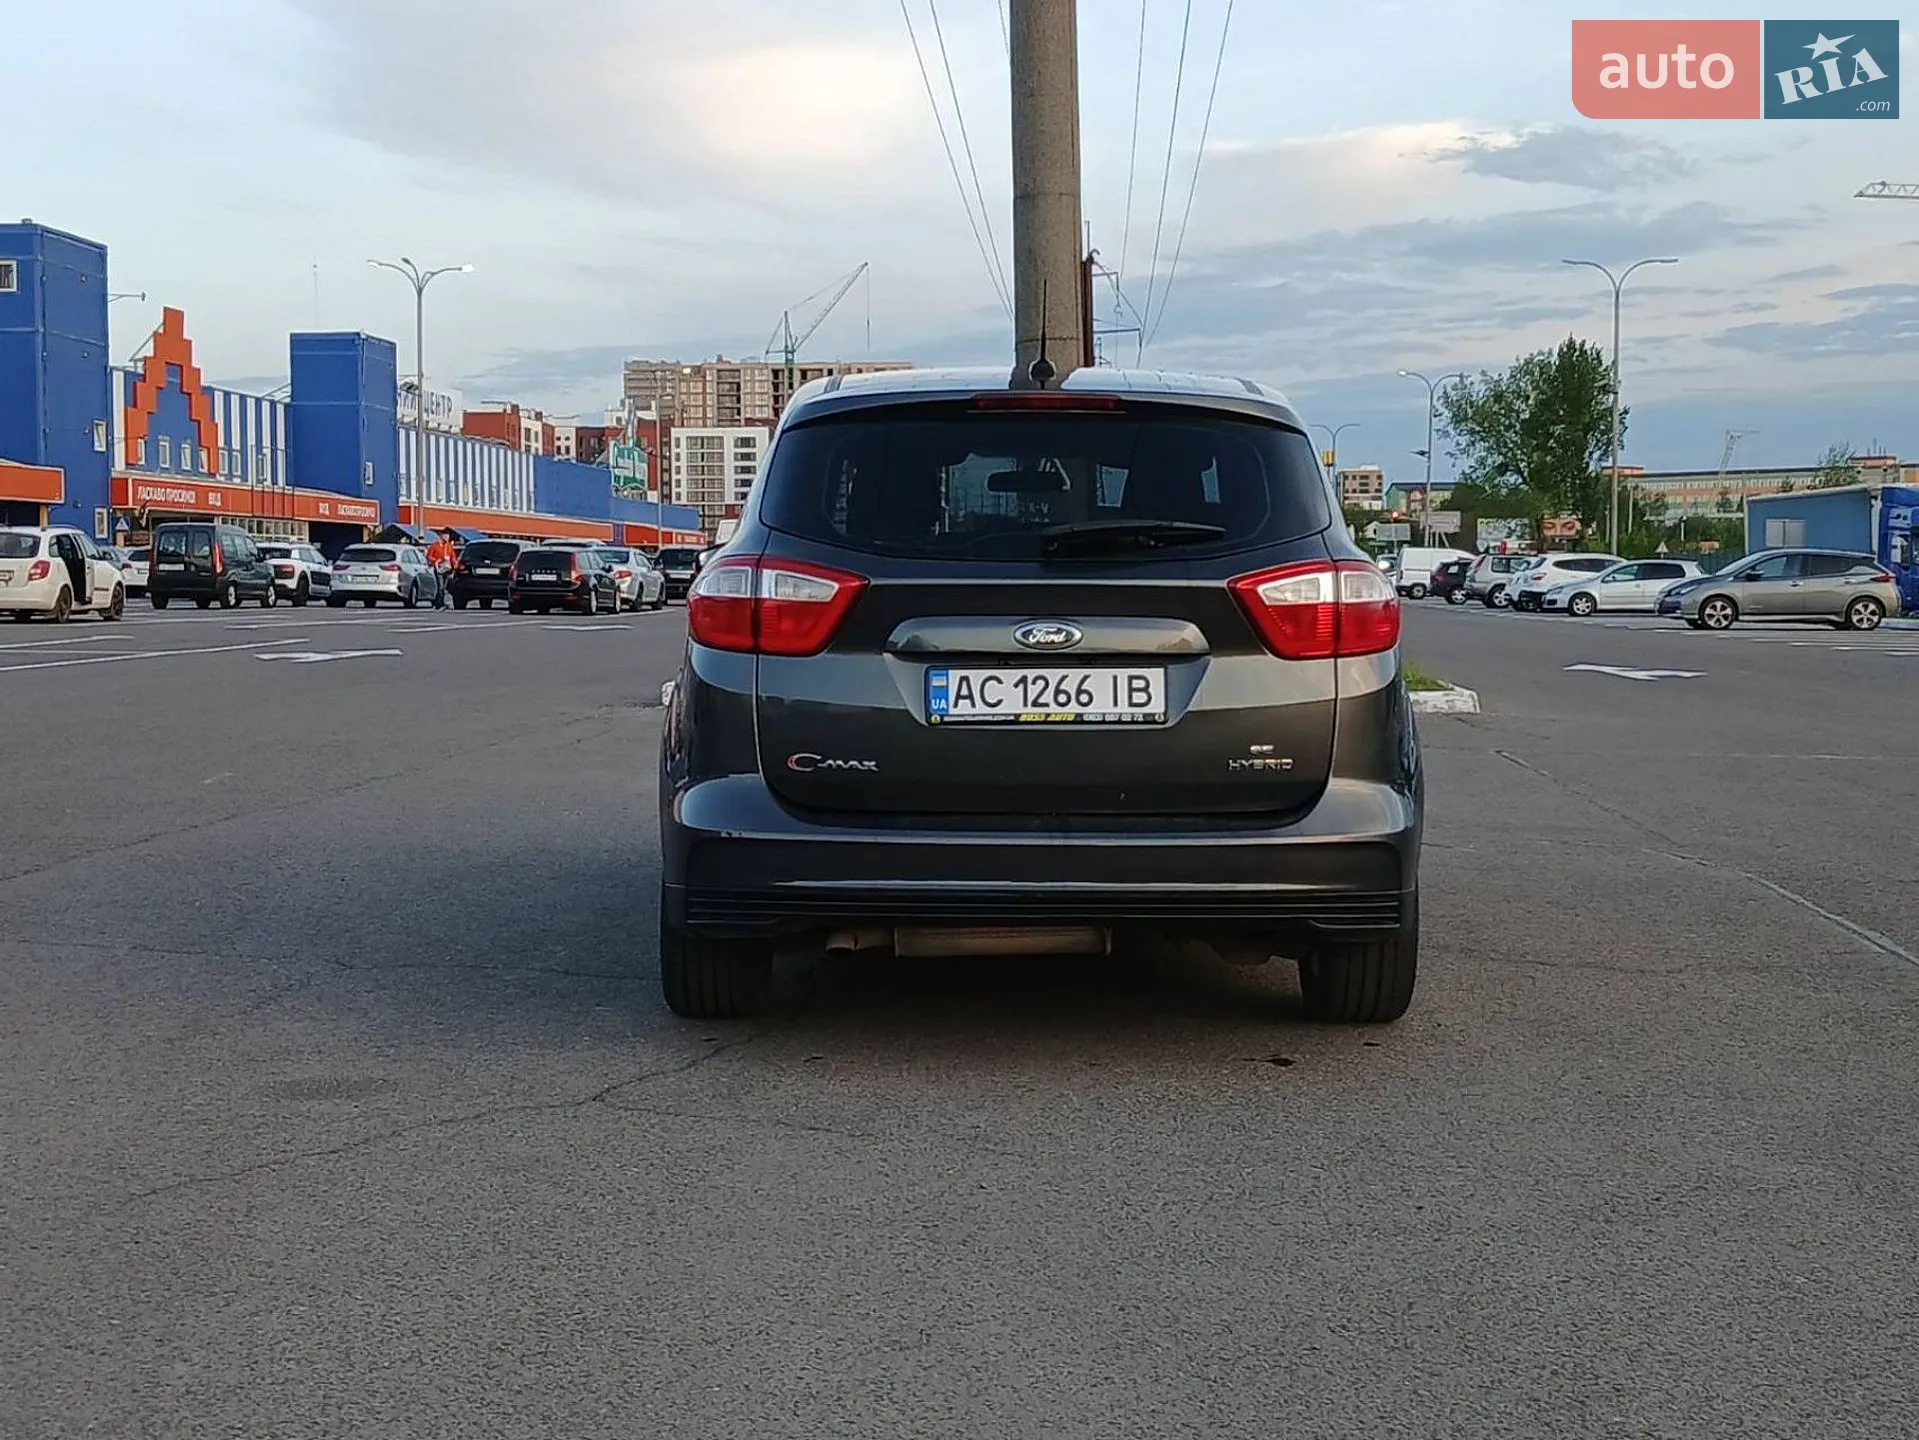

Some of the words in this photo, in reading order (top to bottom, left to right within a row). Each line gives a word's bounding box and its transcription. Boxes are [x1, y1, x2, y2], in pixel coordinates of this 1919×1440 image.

[1028, 627, 1066, 643] Ford
[952, 675, 1004, 708] AC
[1012, 674, 1094, 708] 1266
[1111, 674, 1153, 708] IB
[931, 700, 948, 710] UA
[1228, 758, 1295, 772] HYBRID
